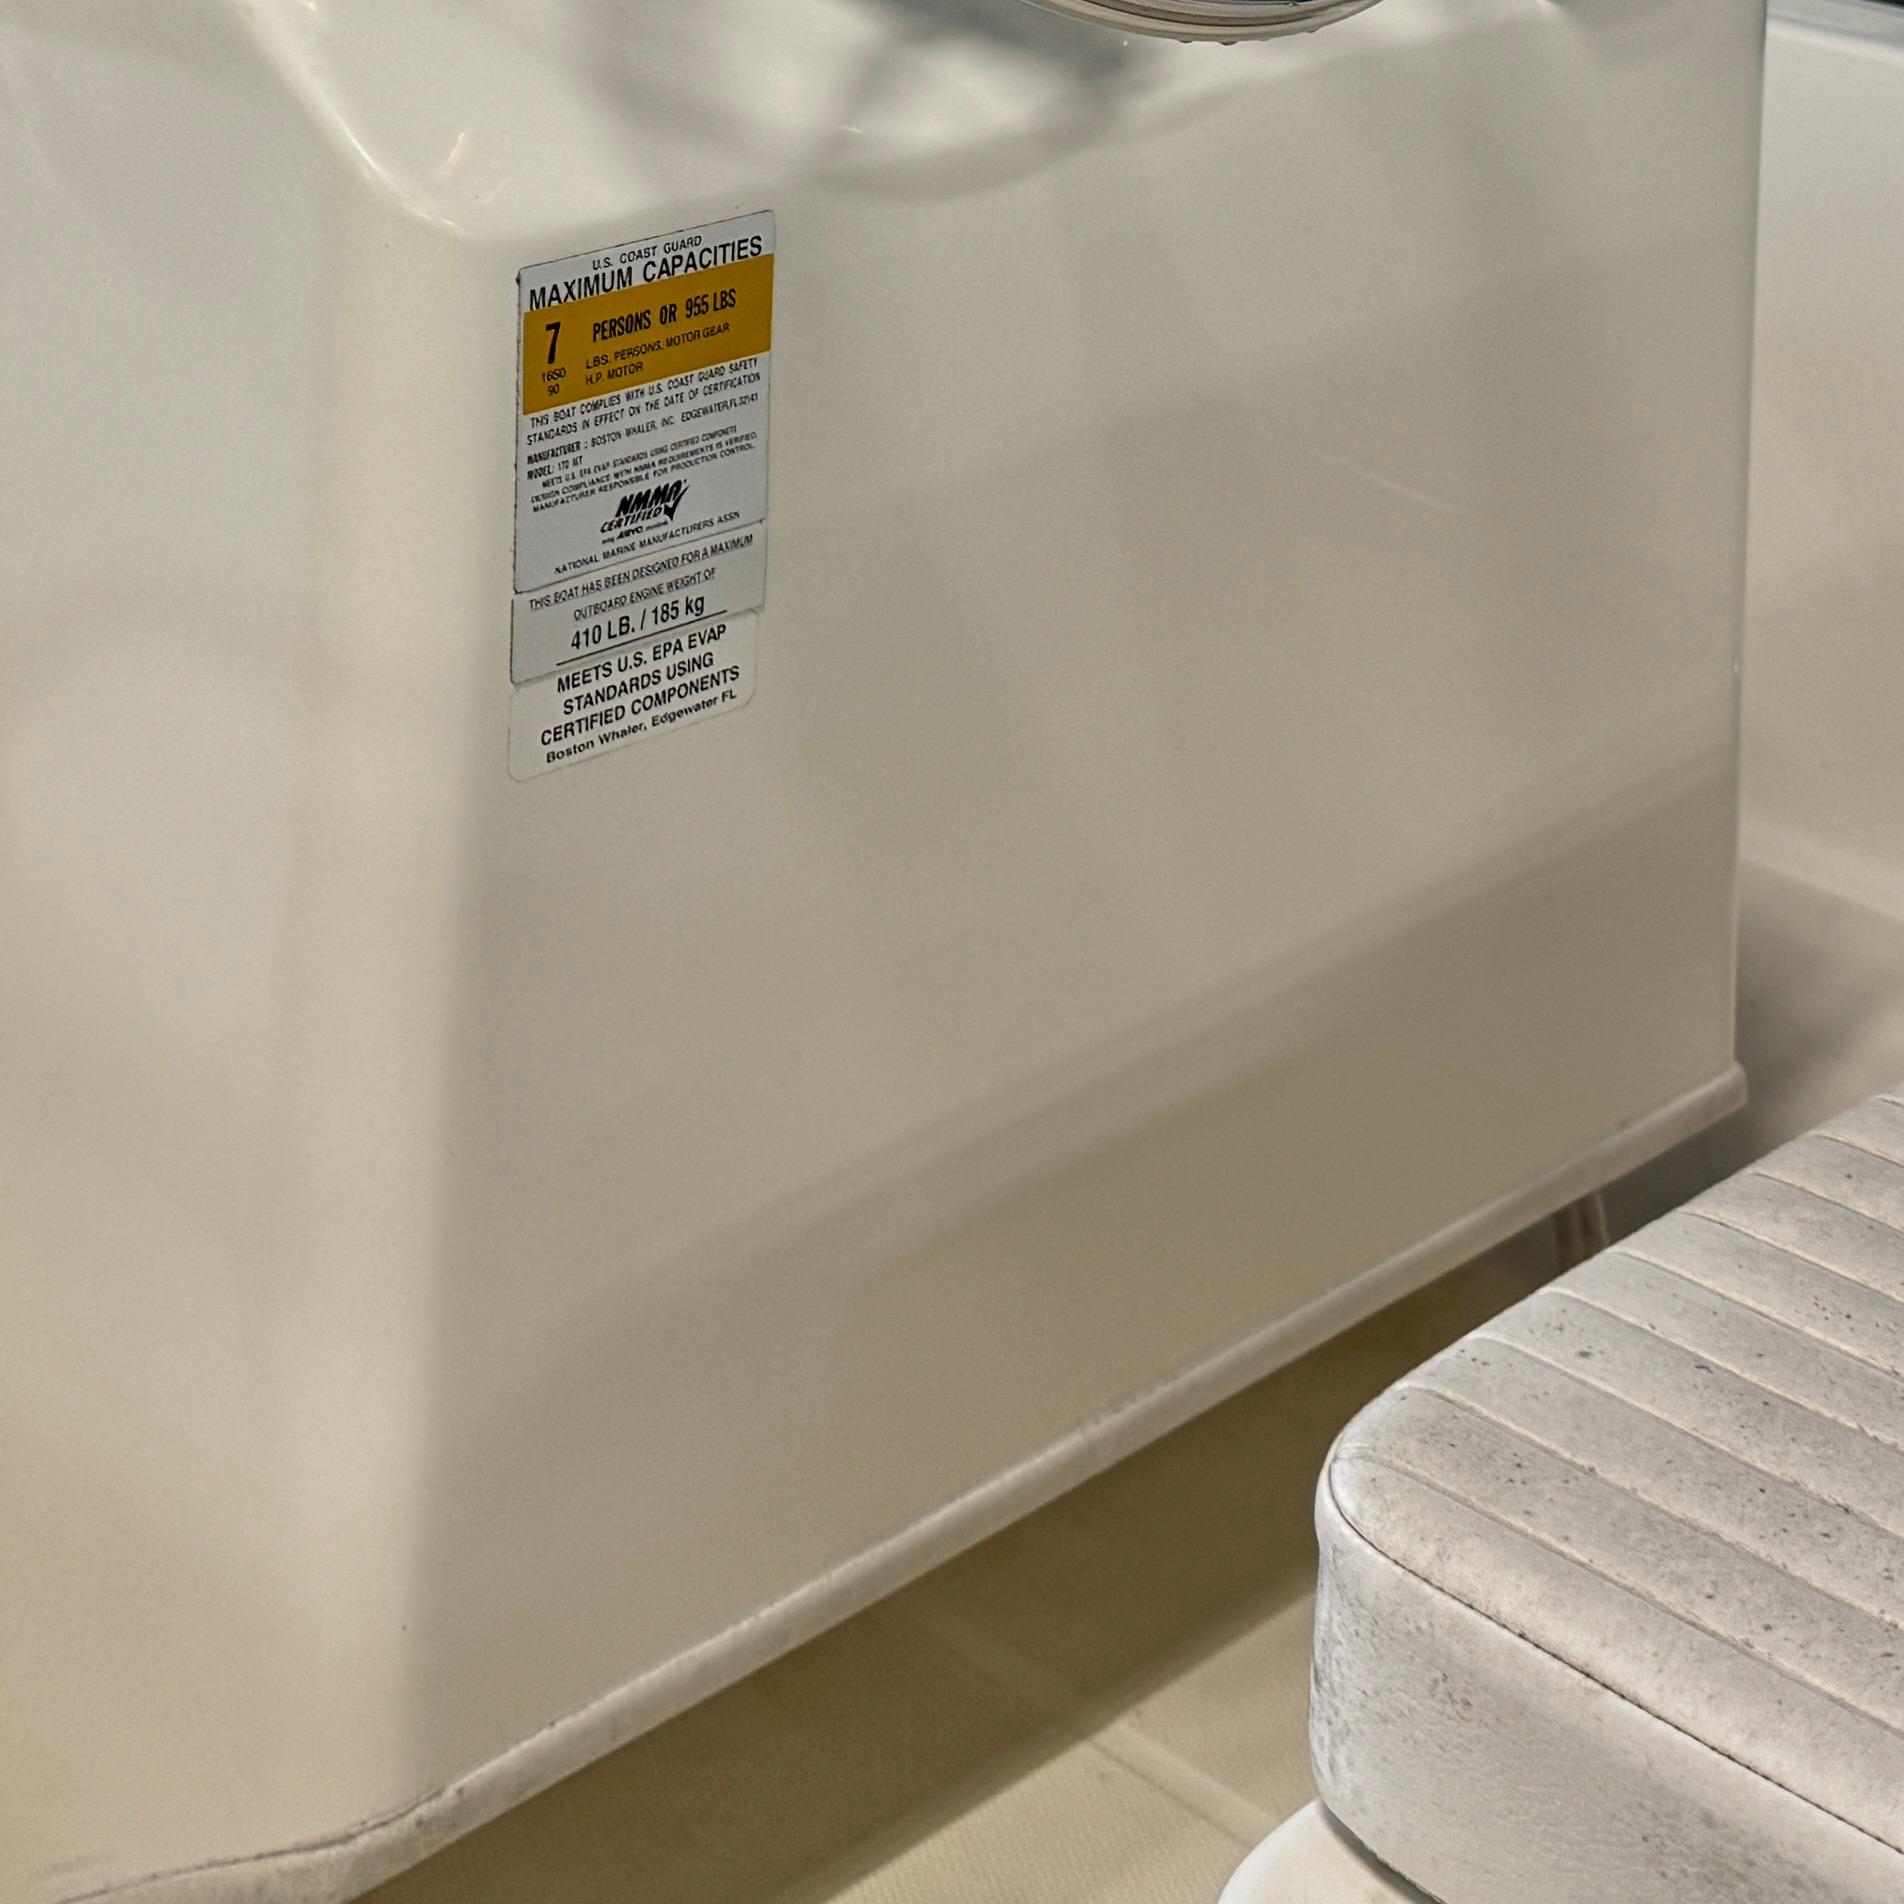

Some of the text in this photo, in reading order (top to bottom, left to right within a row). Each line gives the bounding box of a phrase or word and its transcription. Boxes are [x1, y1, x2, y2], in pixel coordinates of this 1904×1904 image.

[529, 234, 762, 310] MAXIMUM CAPACITIES
[592, 234, 702, 270] U.S. COAST GUARD
[545, 287, 736, 365] 7 PERSONS OR 955 LBS
[702, 321, 730, 338] GEAR
[526, 370, 760, 445] STANDARDS IN EFFECT ON THE DATE OF CERTIFICATION
[530, 413, 549, 428] THIS
[553, 405, 576, 421] BOAT
[580, 394, 620, 414] COMPLIES
[625, 387, 645, 401] WITH
[667, 374, 693, 390] COAST
[697, 365, 725, 382] GUARD
[729, 356, 757, 373] SAFETY
[547, 383, 559, 395] 90
[607, 361, 643, 380] MOTOR
[591, 429, 621, 447] BOSTON
[554, 554, 599, 575] NATIONAL
[602, 542, 636, 560] MARINE
[639, 519, 713, 549] MANUFACTURERS
[599, 505, 662, 533] CERTIFIED
[529, 596, 551, 610] THIS
[553, 587, 578, 602] BOAT
[581, 579, 601, 594] HAS
[604, 571, 630, 587] BEEN
[631, 557, 679, 580] DESIGNED
[681, 549, 700, 563] FOR
[709, 534, 753, 556] MAXIMUM
[573, 567, 716, 620] OUTBOARD ENGINE WEIGHT OF
[571, 625, 601, 650] 410
[606, 615, 635, 639] LB.
[651, 600, 679, 625] 185
[684, 596, 704, 617] kg
[556, 623, 726, 693] MEETS U.S. EPA EVAP
[563, 651, 714, 715] STANDARDS USING
[540, 664, 739, 746] CERTIFIED COMPONENTS
[546, 739, 594, 763] Boston
[651, 696, 718, 727] Edgewater
[722, 689, 737, 702] FL
